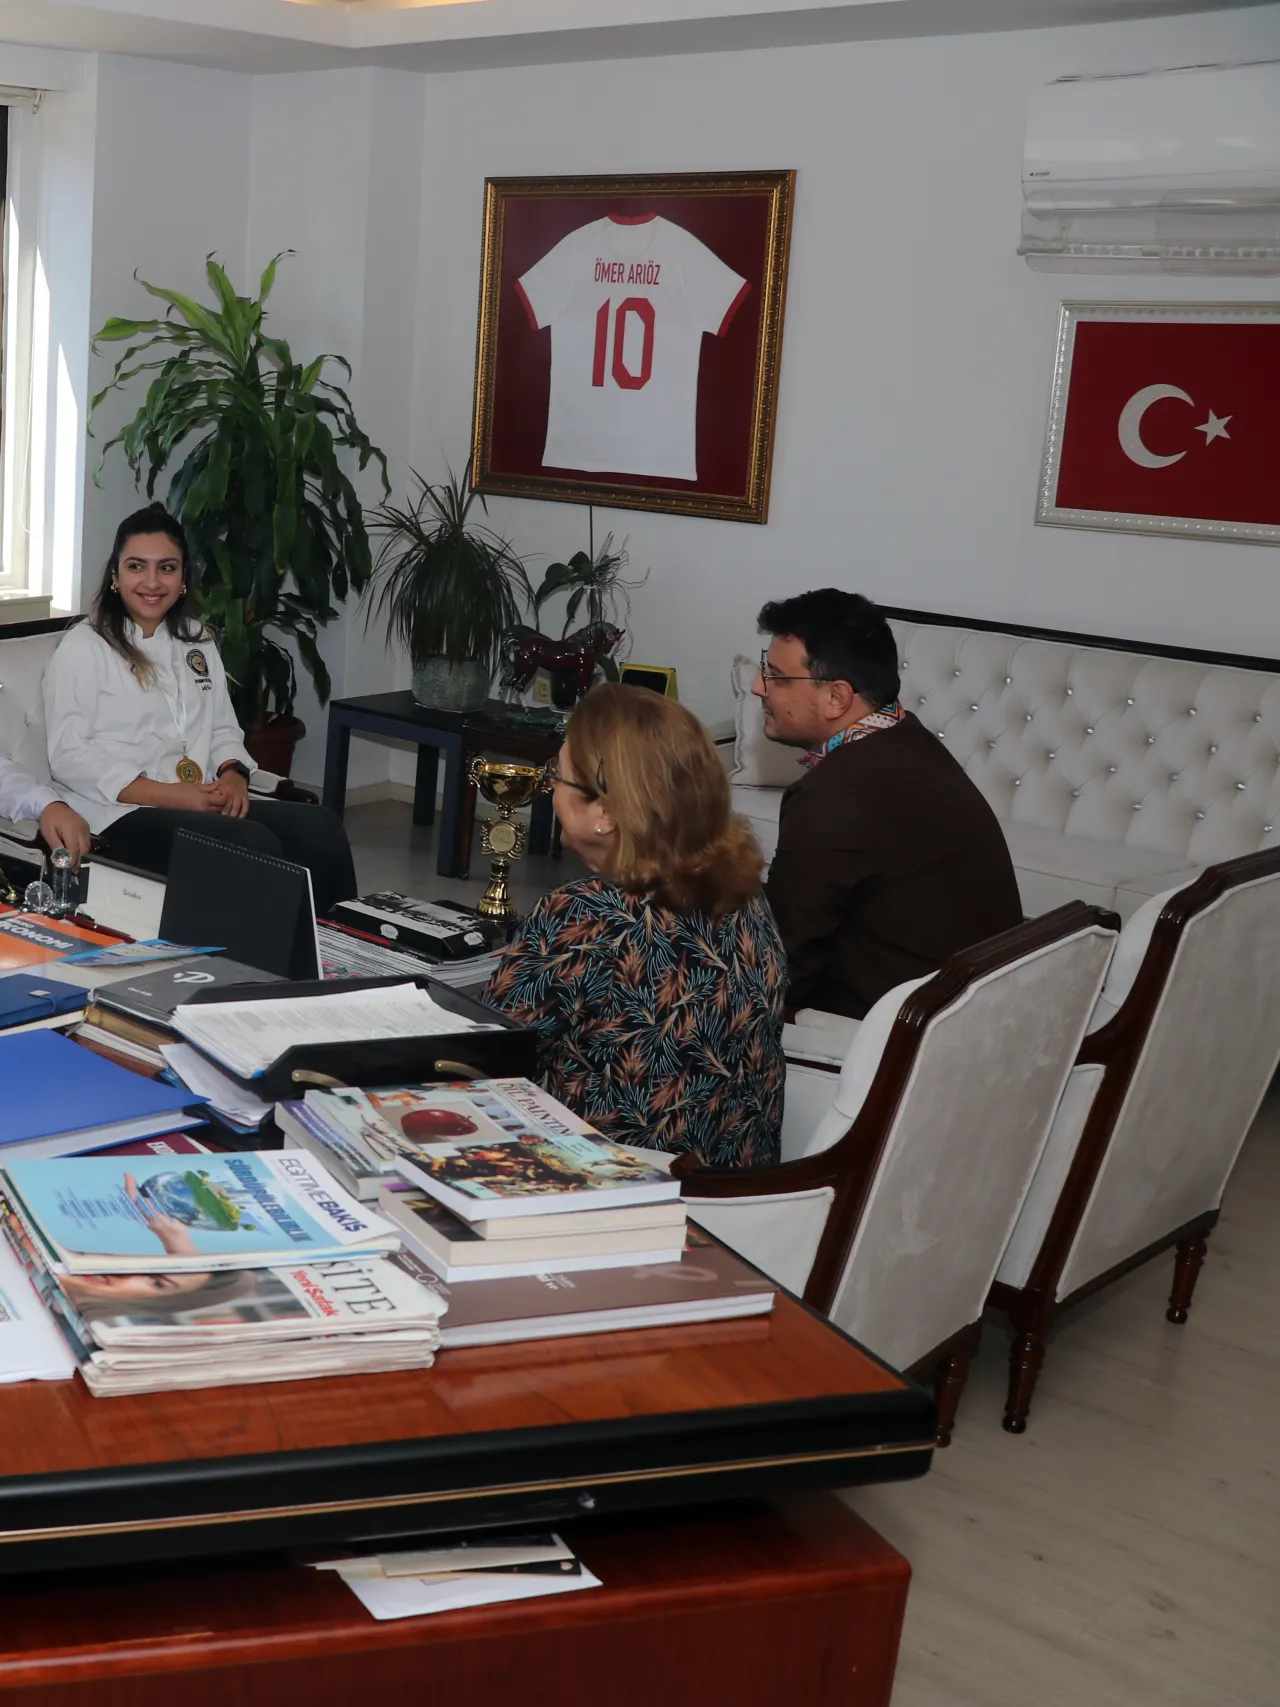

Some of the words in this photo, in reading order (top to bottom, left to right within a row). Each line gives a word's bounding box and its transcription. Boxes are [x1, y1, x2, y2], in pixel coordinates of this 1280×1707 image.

[594, 258, 625, 284] ÖMER
[627, 260, 661, 286] ARIÖZ
[592, 297, 656, 390] 10
[518, 1098, 571, 1136] PAINTIN
[290, 1270, 319, 1288] Yeni
[305, 1287, 340, 1318] Şafak
